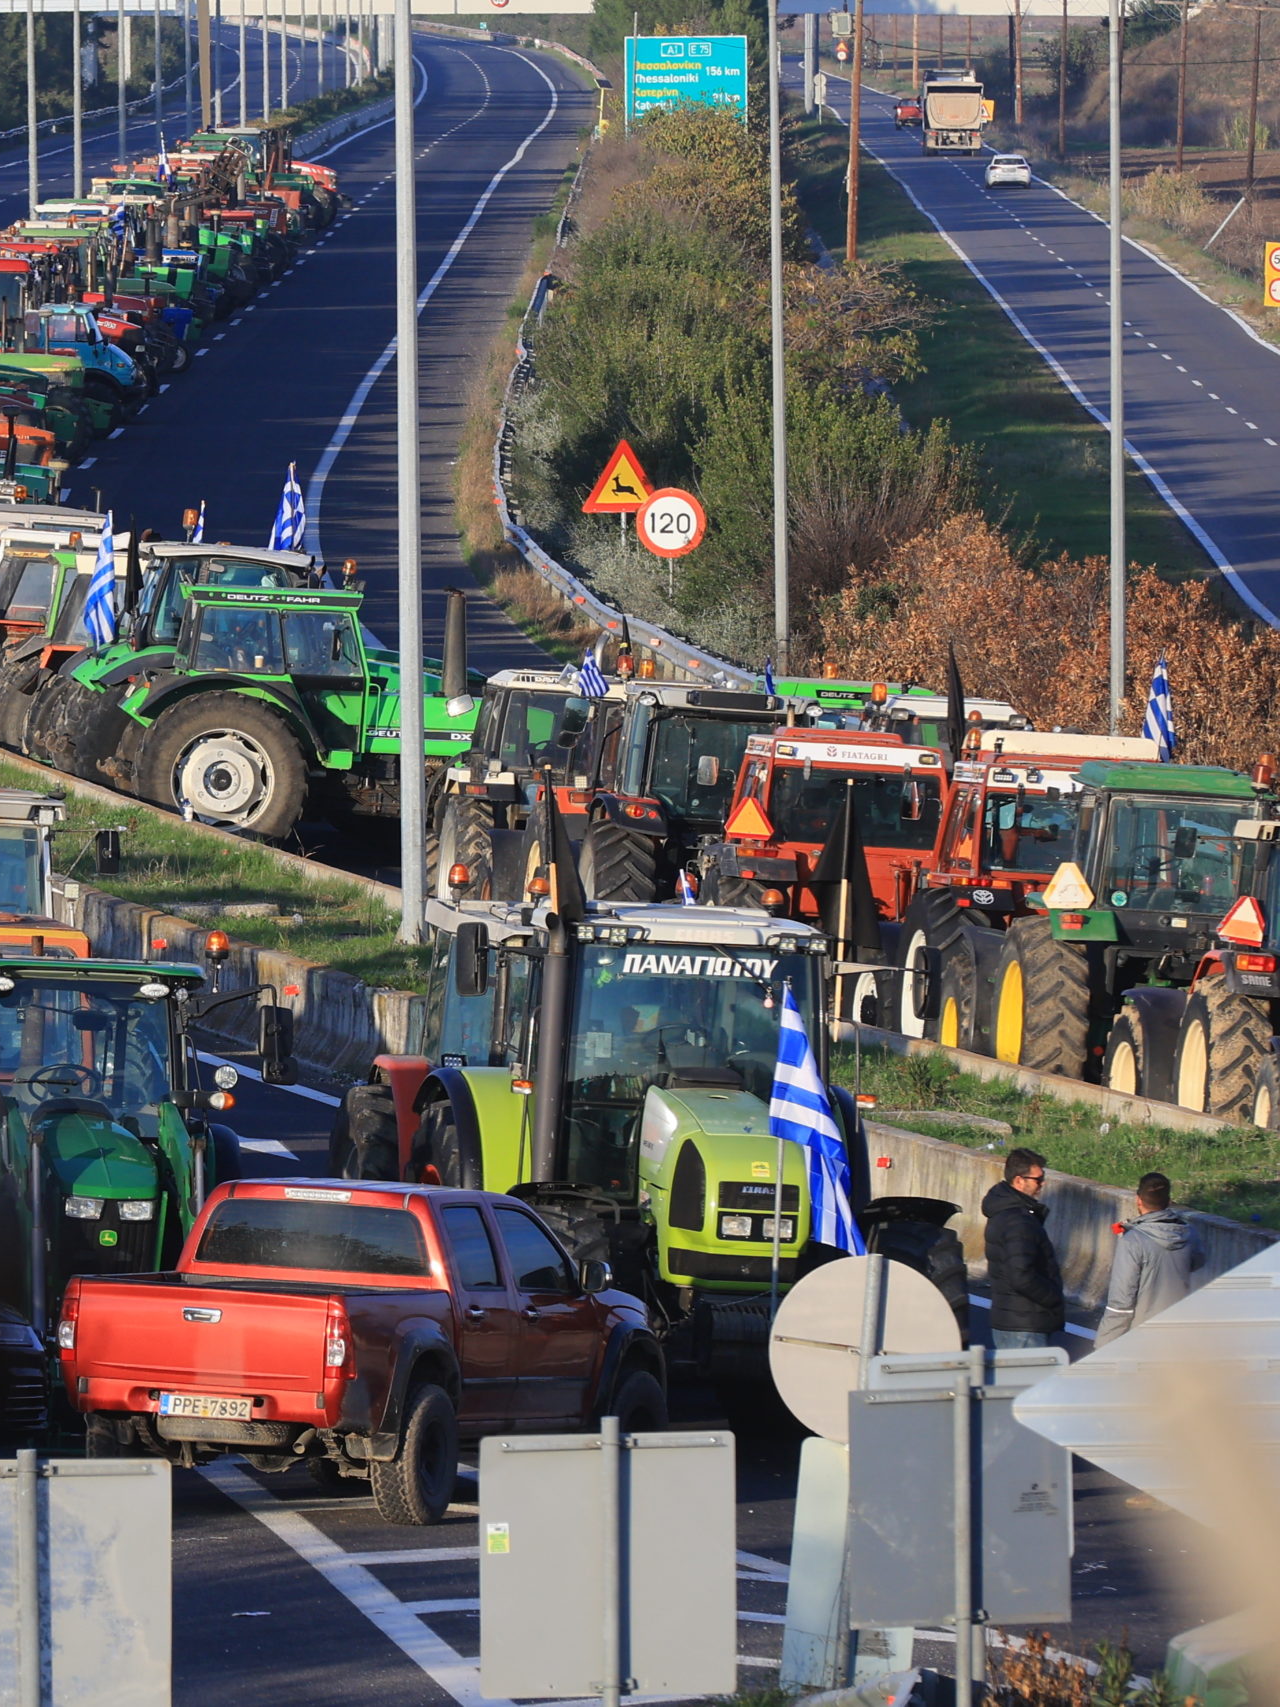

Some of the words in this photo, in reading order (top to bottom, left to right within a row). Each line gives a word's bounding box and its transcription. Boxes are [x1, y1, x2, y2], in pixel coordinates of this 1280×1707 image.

[667, 45, 678, 54] A1
[690, 46, 697, 54] E
[699, 46, 709, 54] 75
[705, 66, 722, 76] 156
[724, 66, 740, 76] km
[635, 73, 699, 83] Thessaloniki
[650, 512, 691, 534] 120
[227, 593, 269, 602] DEUTZ
[820, 691, 856, 699] DEUTZ
[450, 732, 473, 741] DX
[841, 750, 888, 761] FIATAGRI
[622, 953, 780, 978] ΠΑΝΑΓΙΩΤΟΥ
[1241, 974, 1272, 987] SAME
